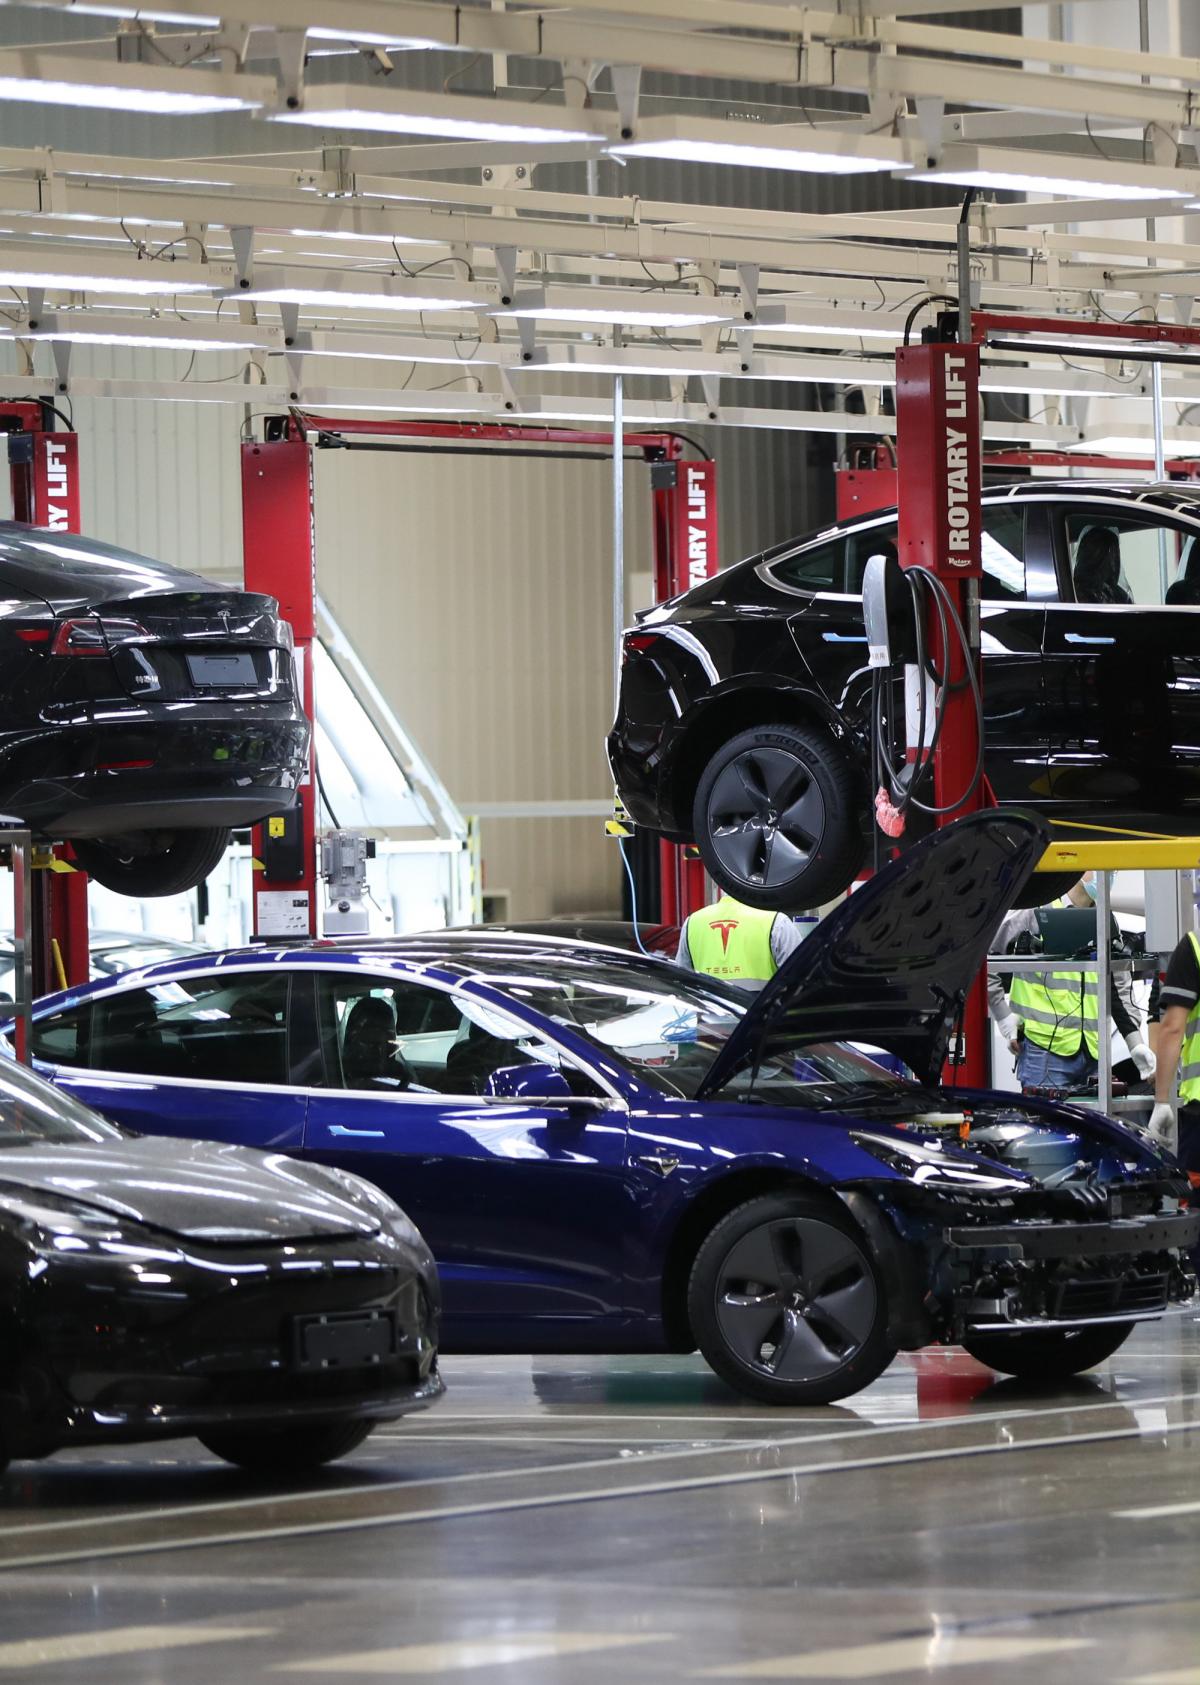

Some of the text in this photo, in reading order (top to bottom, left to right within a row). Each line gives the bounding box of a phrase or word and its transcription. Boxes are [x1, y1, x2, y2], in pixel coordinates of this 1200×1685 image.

[46, 440, 68, 497] LIFT
[945, 353, 970, 550] ROTARY LIFT
[687, 467, 706, 519] LIFT
[706, 966, 741, 974] TESLA
